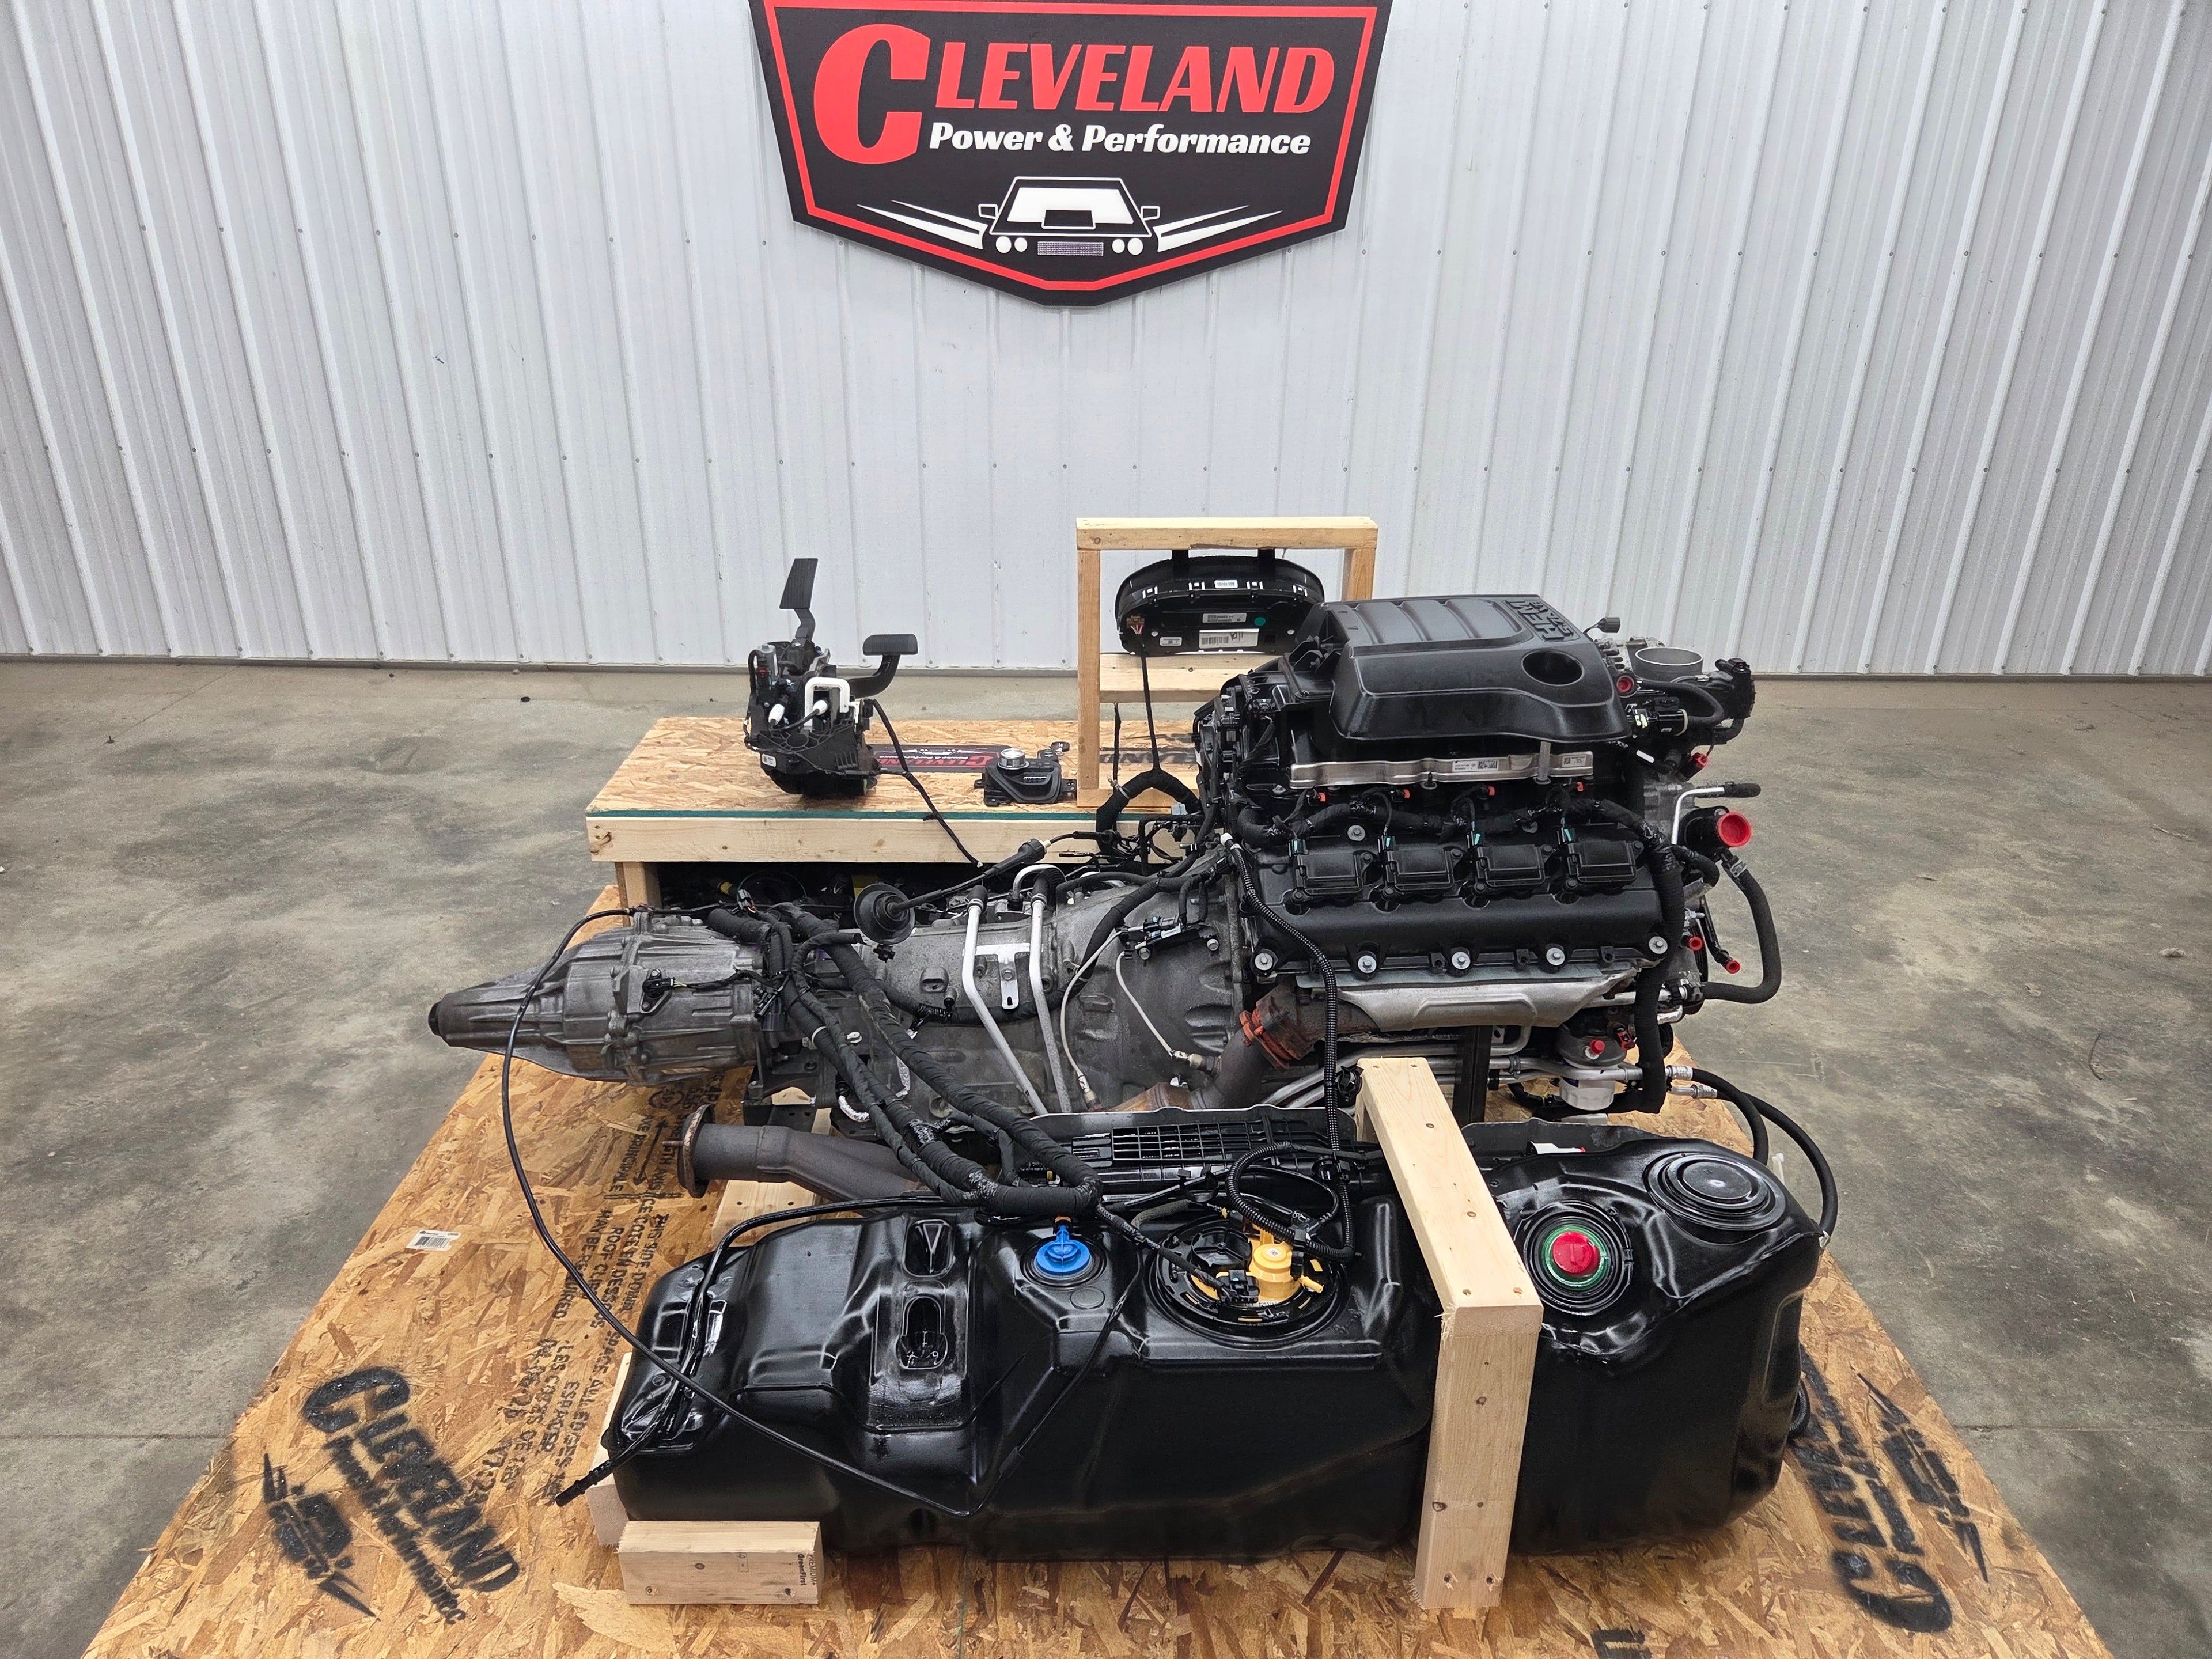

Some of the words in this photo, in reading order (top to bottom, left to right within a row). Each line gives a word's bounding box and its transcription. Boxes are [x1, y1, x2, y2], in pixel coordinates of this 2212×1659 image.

[813, 23, 1335, 165] CLEVELAND
[929, 122, 1042, 151] Power
[1048, 122, 1074, 153] &
[1081, 123, 1312, 156] Performance
[601, 1228, 623, 1260] ROOF
